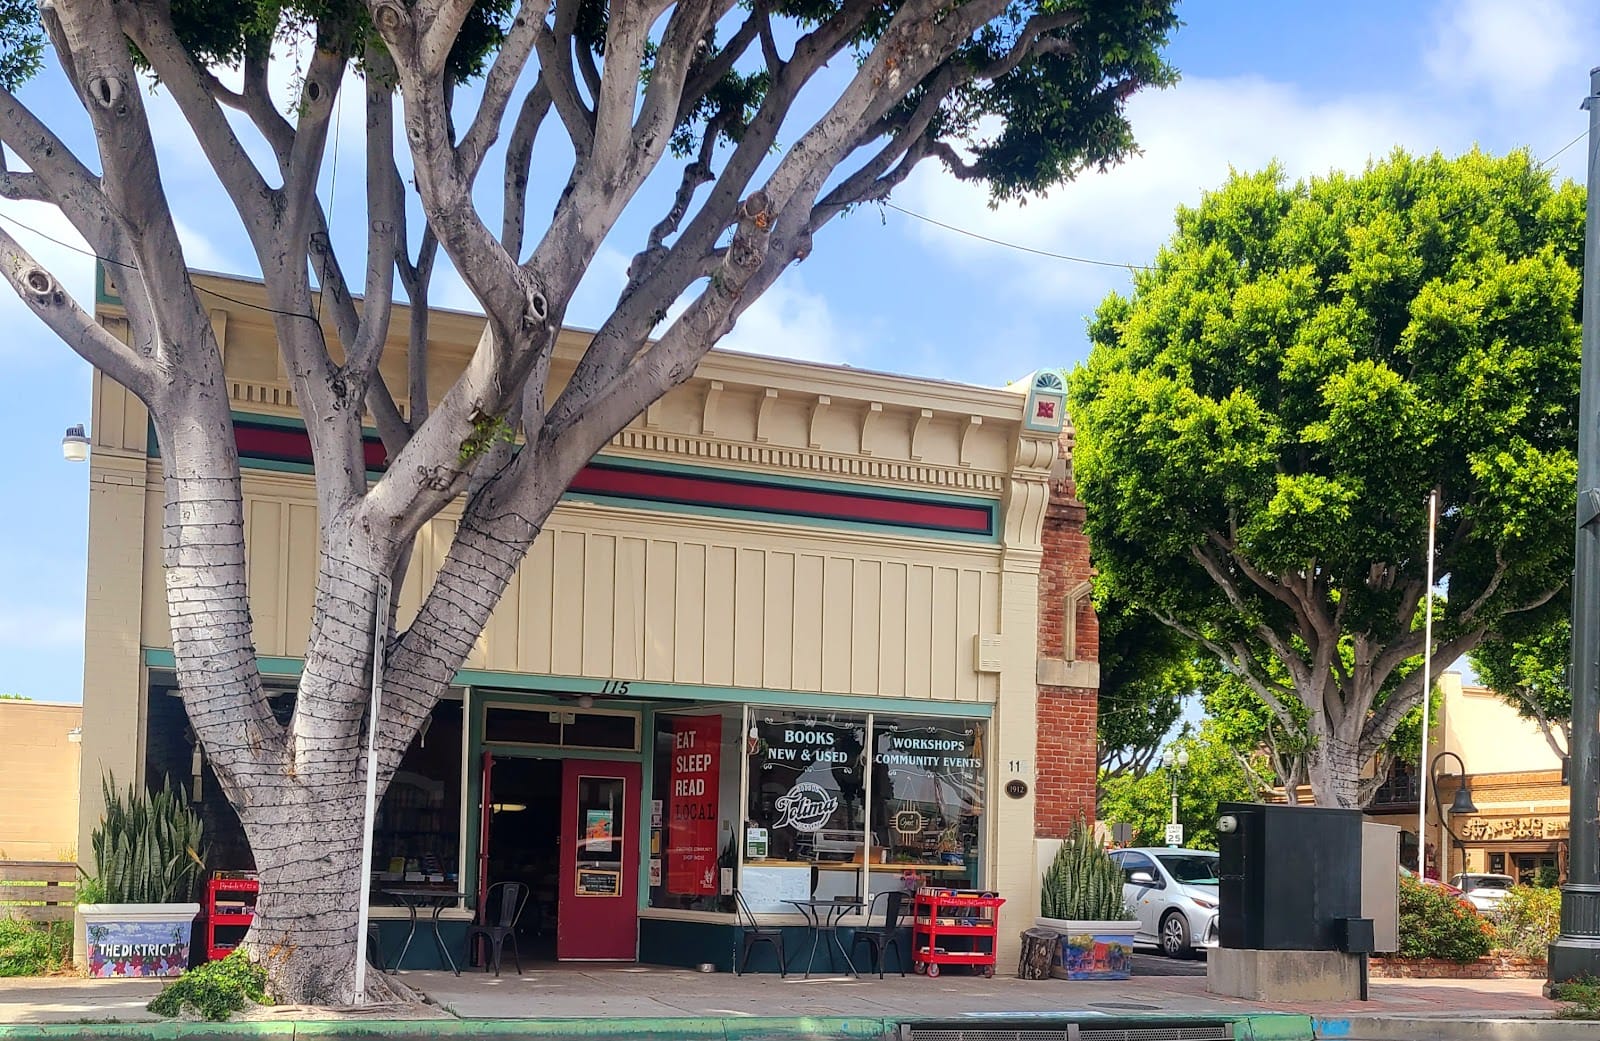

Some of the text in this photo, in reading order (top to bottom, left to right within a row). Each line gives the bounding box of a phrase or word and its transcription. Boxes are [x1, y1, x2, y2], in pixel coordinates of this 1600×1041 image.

[602, 680, 631, 695] 115
[676, 730, 697, 749] EAT
[784, 729, 835, 746] BOOKS
[893, 738, 966, 752] WORKSHOPS
[768, 748, 848, 763] NEW & USED
[875, 754, 981, 768] COMMUNITY EVENTS
[676, 754, 712, 773] SLEEP
[1009, 760, 1020, 773] 11
[675, 778, 705, 797] READ
[1010, 785, 1025, 793] 1912
[675, 803, 716, 820] LOCAL
[1168, 834, 1181, 842] 25
